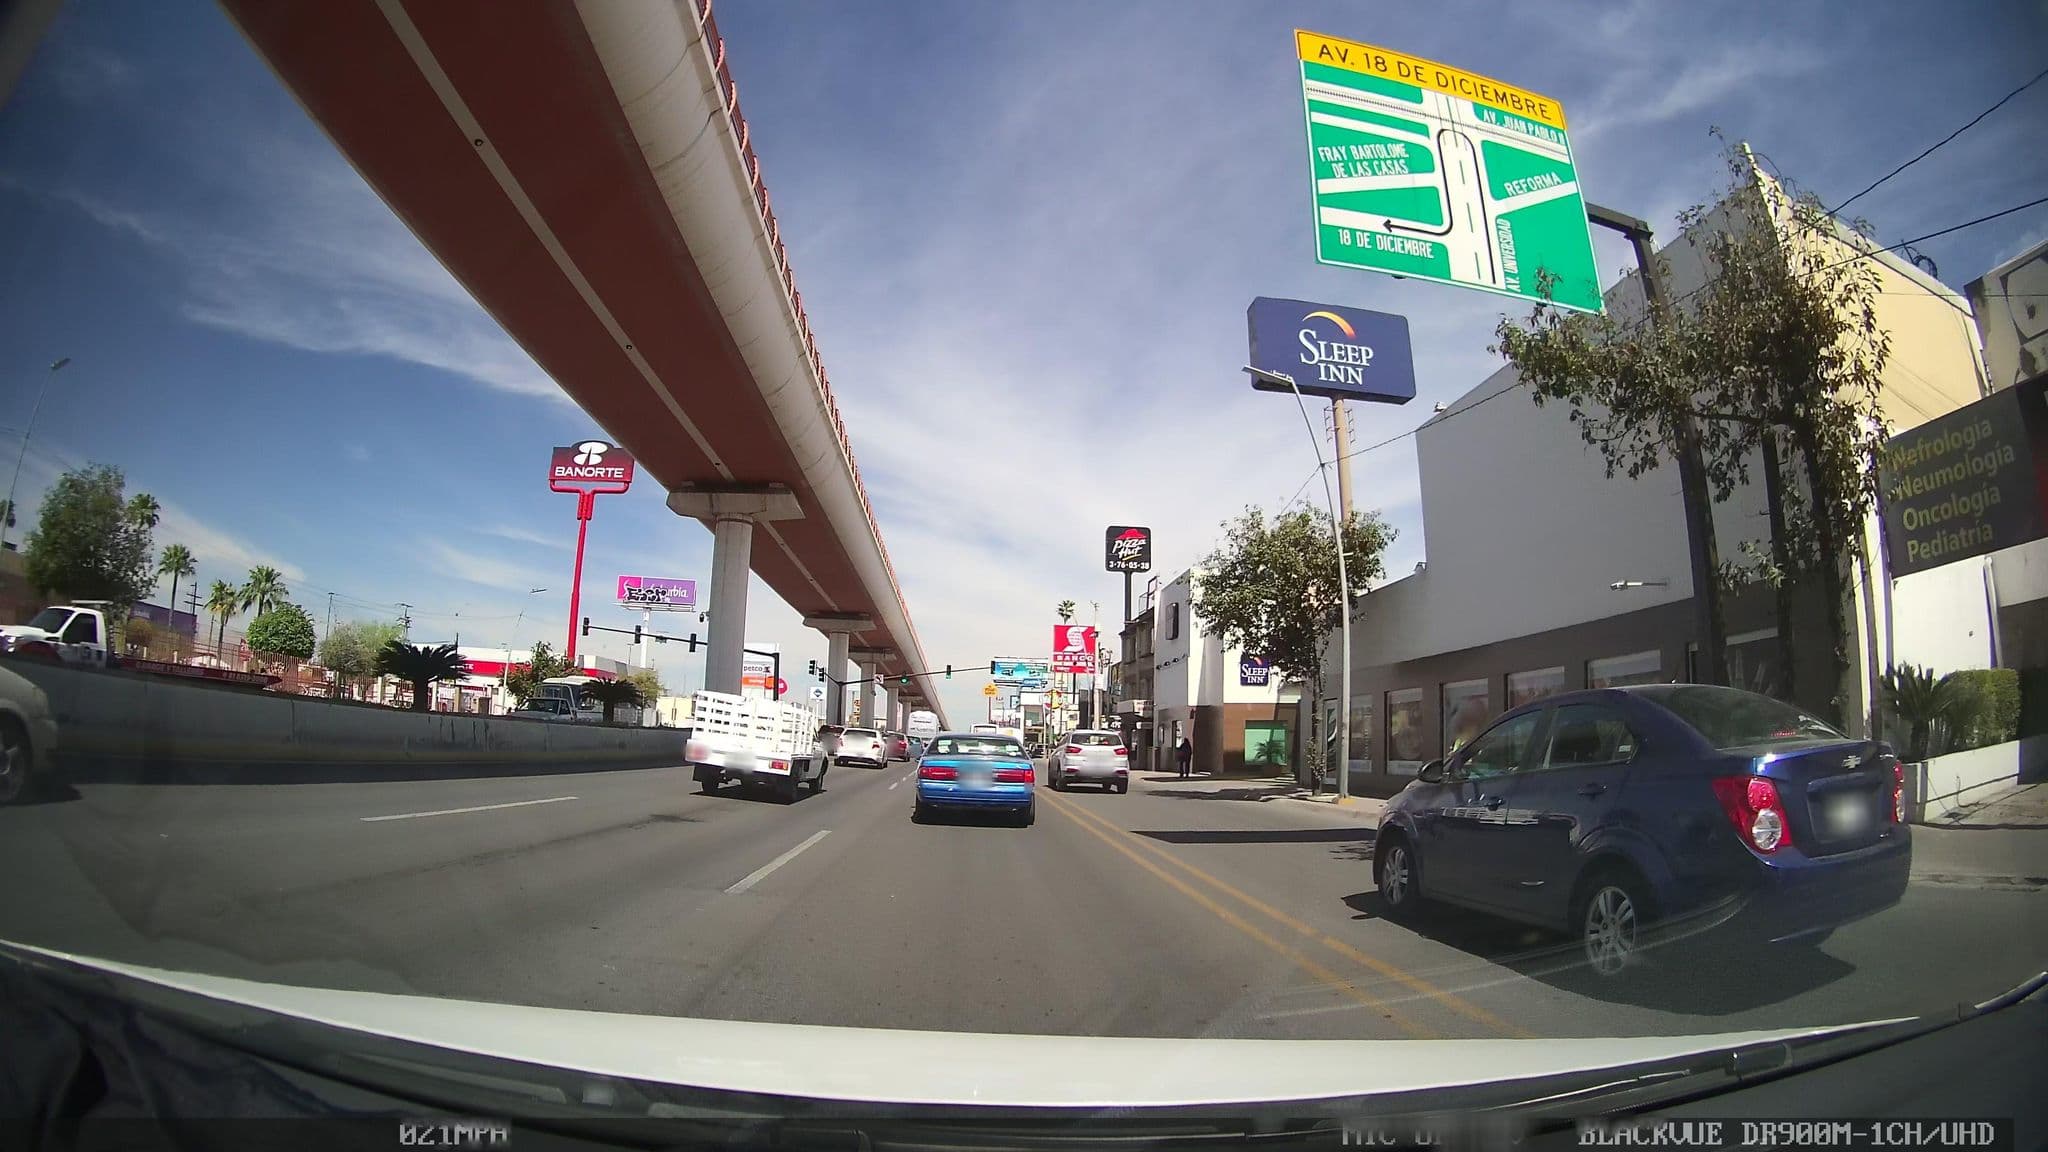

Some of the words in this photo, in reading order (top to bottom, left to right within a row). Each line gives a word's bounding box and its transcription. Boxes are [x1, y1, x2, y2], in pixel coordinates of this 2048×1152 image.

[1318, 43, 1355, 66] AV.
[1365, 53, 1388, 72] 18
[1397, 61, 1428, 83] DE
[1436, 71, 1552, 120] DICIEMBRE
[1483, 109, 1500, 126] AV.
[1503, 115, 1528, 134] JUAN
[1527, 122, 1558, 142] PABLO
[1317, 145, 1348, 162] FRAY
[1349, 143, 1410, 160] BARTOLOME
[1331, 162, 1349, 178] DE
[1349, 161, 1372, 177] LAS
[1373, 159, 1409, 176] CASAS
[1504, 171, 1562, 196] REFORMA
[1338, 229, 1352, 246] 18
[1355, 231, 1372, 249] DE
[1376, 234, 1435, 259] DICIEMBRE
[1496, 218, 1518, 274] UNIVERSIDAD
[1298, 329, 1374, 366] SLEEP
[1318, 363, 1363, 385] INN
[554, 466, 625, 478] BANORTE
[1903, 483, 2002, 532] Oncología
[1118, 546, 1143, 558] Hut
[1906, 520, 1994, 563] Pediatría
[743, 664, 763, 672] petco
[1241, 663, 1268, 677] SLEEP
[1247, 675, 1265, 684] INN
